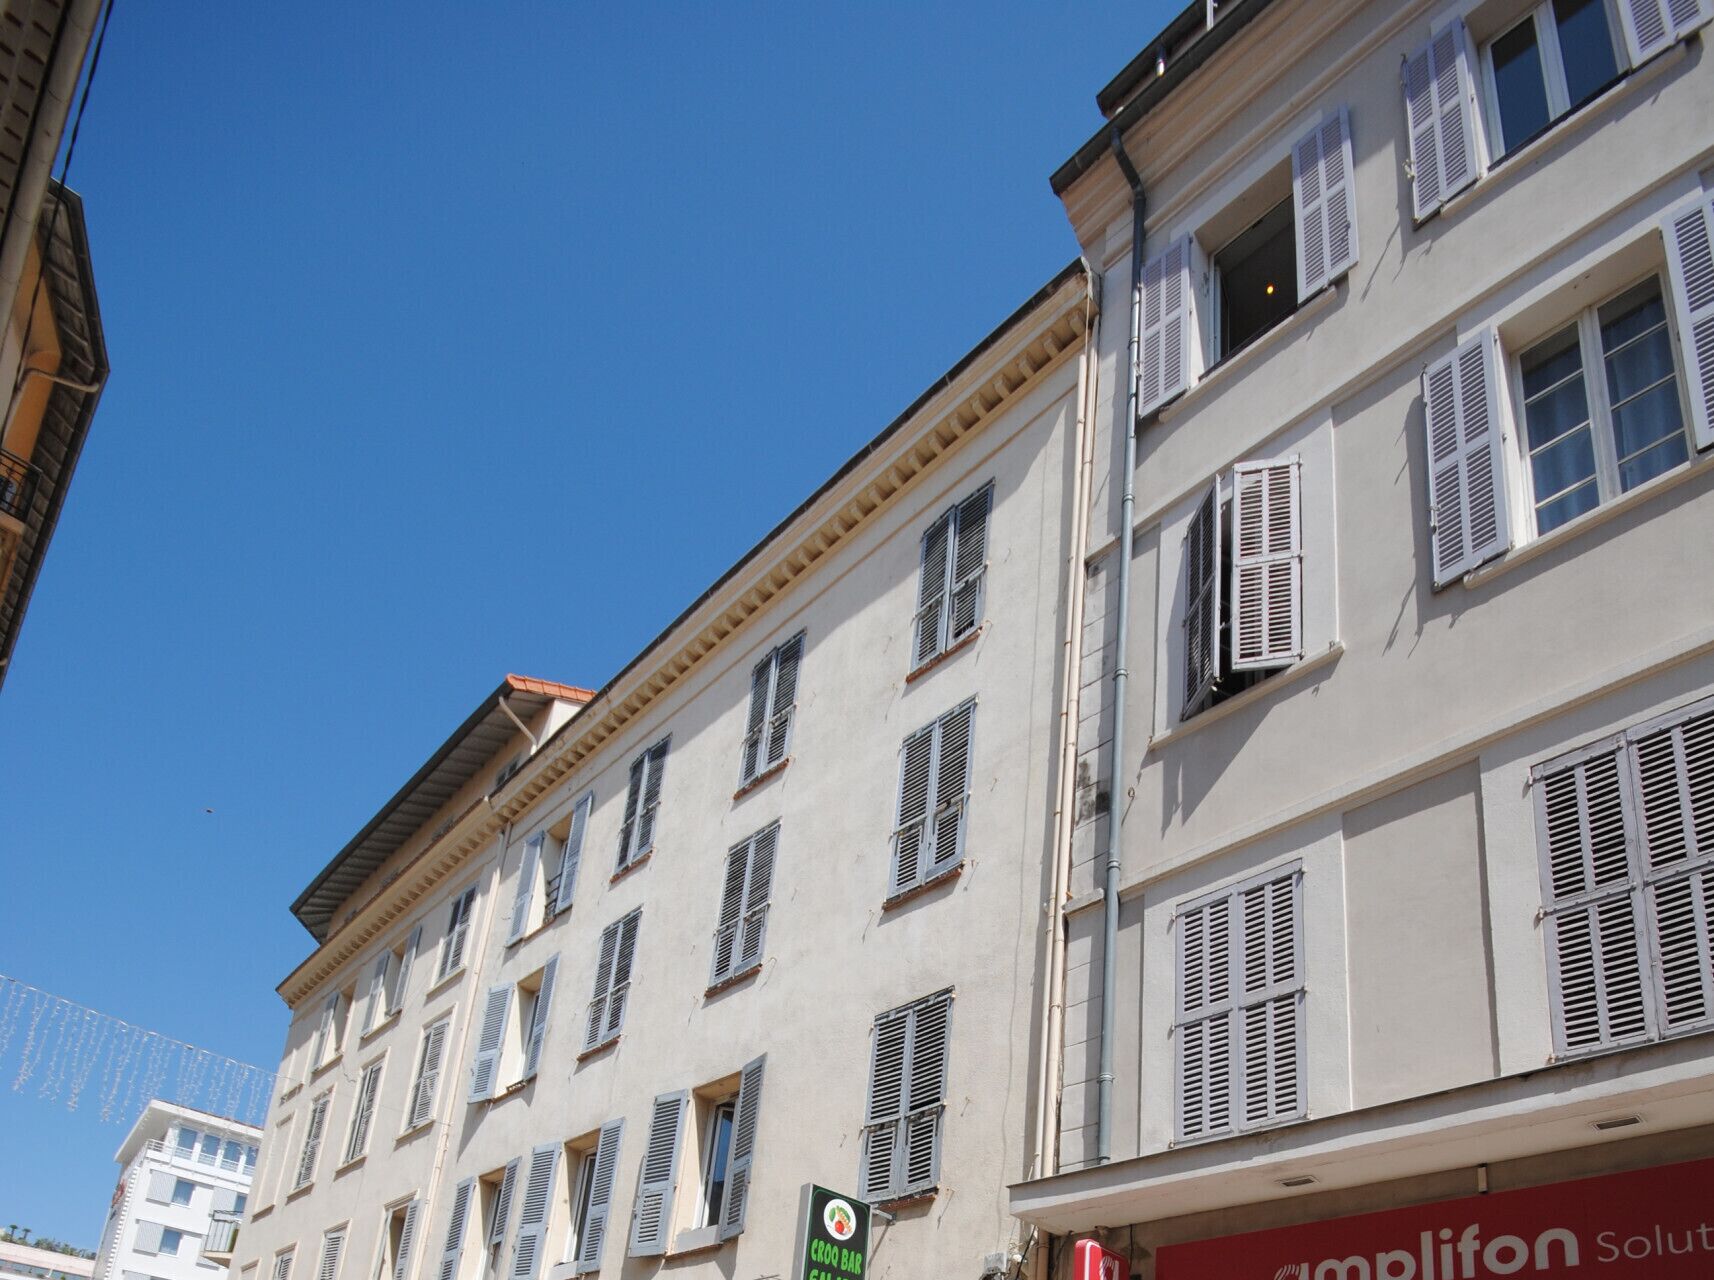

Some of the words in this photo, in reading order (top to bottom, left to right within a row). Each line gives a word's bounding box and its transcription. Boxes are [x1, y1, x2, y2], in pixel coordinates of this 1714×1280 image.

[811, 1239, 839, 1267] CROQ
[841, 1248, 862, 1274] BAR
[1597, 1223, 1714, 1262] Solut
